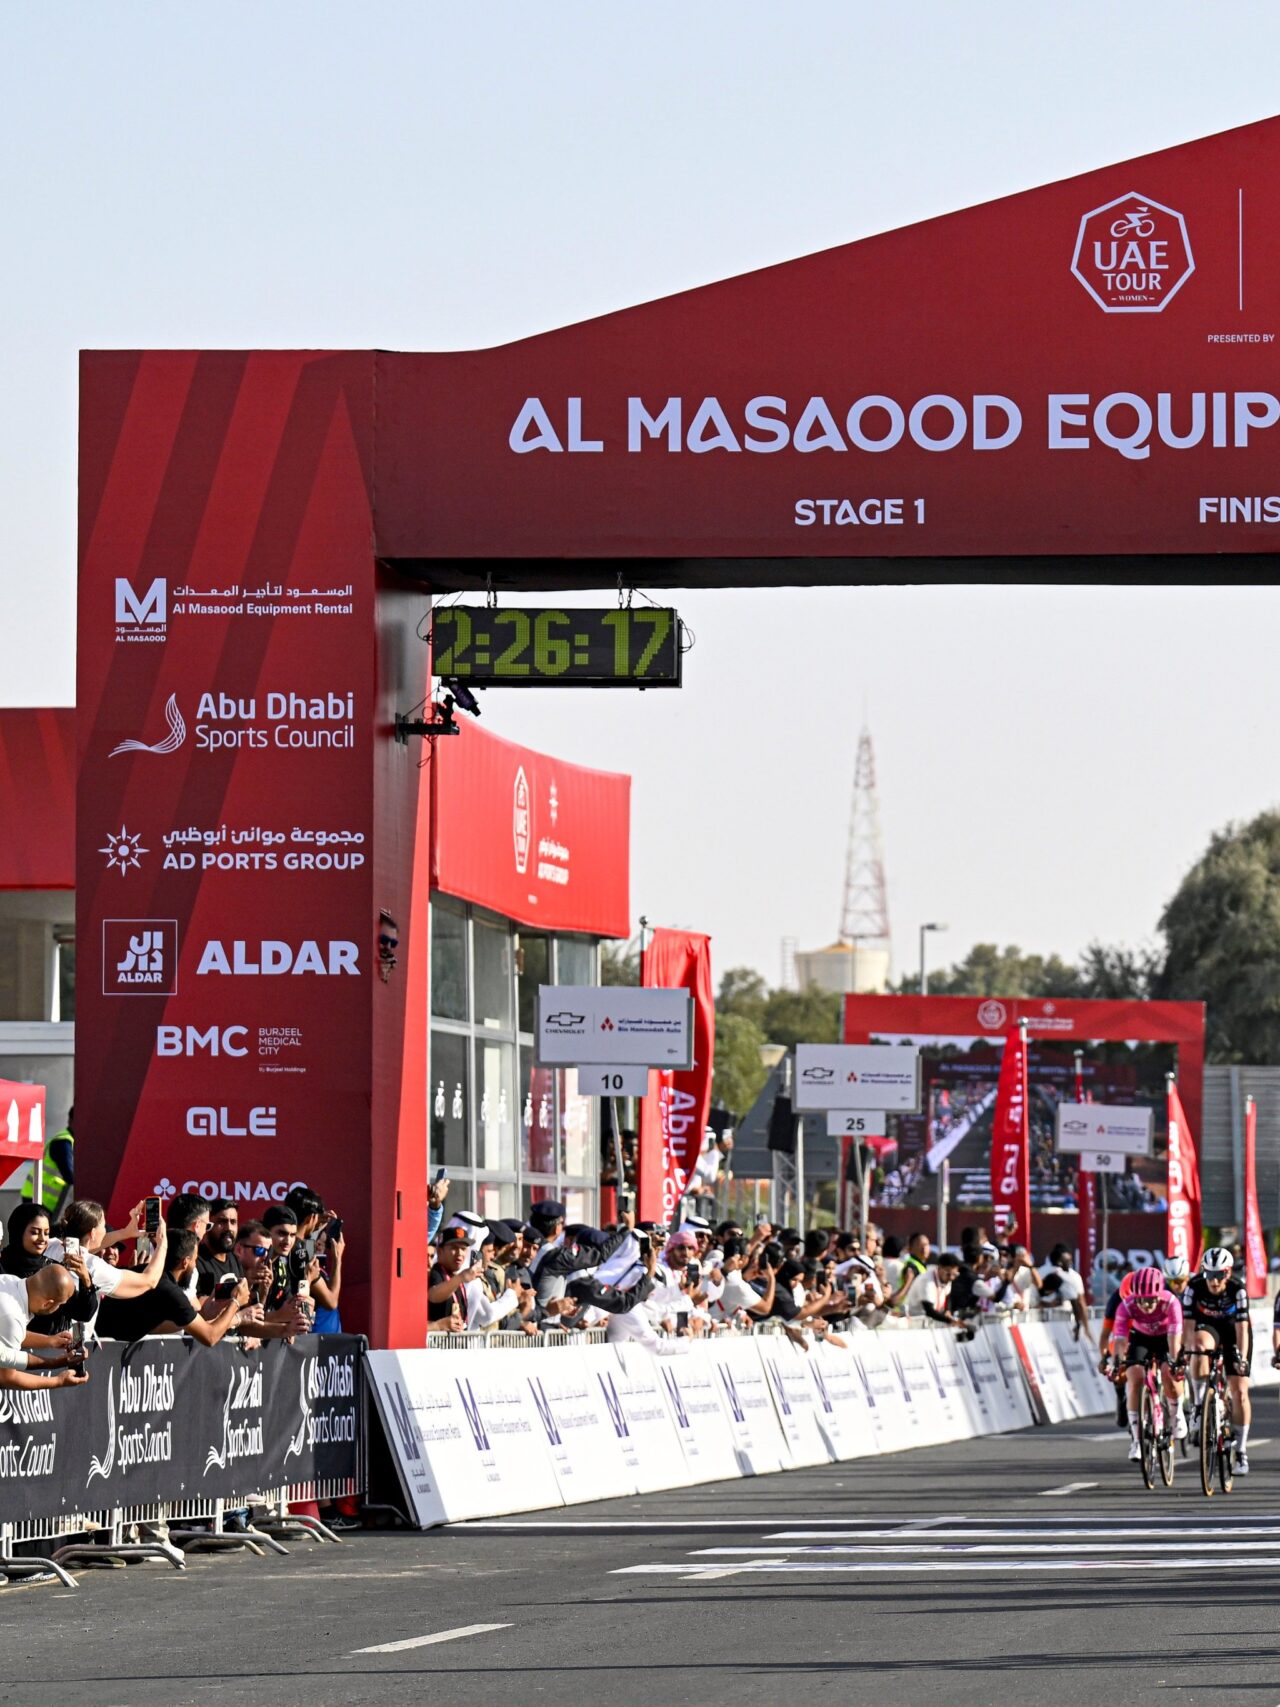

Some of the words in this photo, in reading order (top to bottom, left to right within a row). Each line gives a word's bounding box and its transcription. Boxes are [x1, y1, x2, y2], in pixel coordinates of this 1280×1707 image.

[1094, 241, 1169, 270] UAE
[1103, 273, 1162, 291] TOUR
[1207, 334, 1260, 344] PRESENTED
[1262, 334, 1276, 343] BY
[507, 396, 604, 453] AL
[627, 395, 1023, 453] MASAOOD
[793, 498, 904, 526] STAGE
[913, 499, 926, 524] 1
[172, 603, 186, 614] Al
[188, 603, 245, 614] Masaood
[246, 603, 312, 616] Equipment
[314, 603, 353, 615] Rental
[115, 634, 126, 642] AL
[127, 634, 167, 642] MASAOOD
[196, 692, 256, 720] Abu
[266, 692, 354, 720] Dhabi
[195, 724, 268, 752] Sports
[274, 725, 355, 749] Council
[162, 823, 227, 845] أبوظبي
[290, 826, 366, 846] مجموعة
[162, 853, 196, 870] AD
[202, 853, 278, 870] PORTS
[283, 852, 366, 870] GROUP
[196, 940, 362, 975] ALDAR
[117, 972, 163, 983] ALDAR
[156, 1025, 249, 1057] BMC
[258, 1027, 303, 1036] BURJEEL
[258, 1037, 302, 1046] MEDICAL
[258, 1046, 280, 1055] CITY
[600, 1074, 623, 1090] 10
[668, 1087, 696, 1157] Abu
[846, 1118, 865, 1131] 25
[1096, 1154, 1111, 1166] 50
[119, 1364, 142, 1414] Abu
[142, 1362, 175, 1412] Dhabi
[117, 1424, 144, 1475] Sports
[143, 1420, 172, 1462] Council
